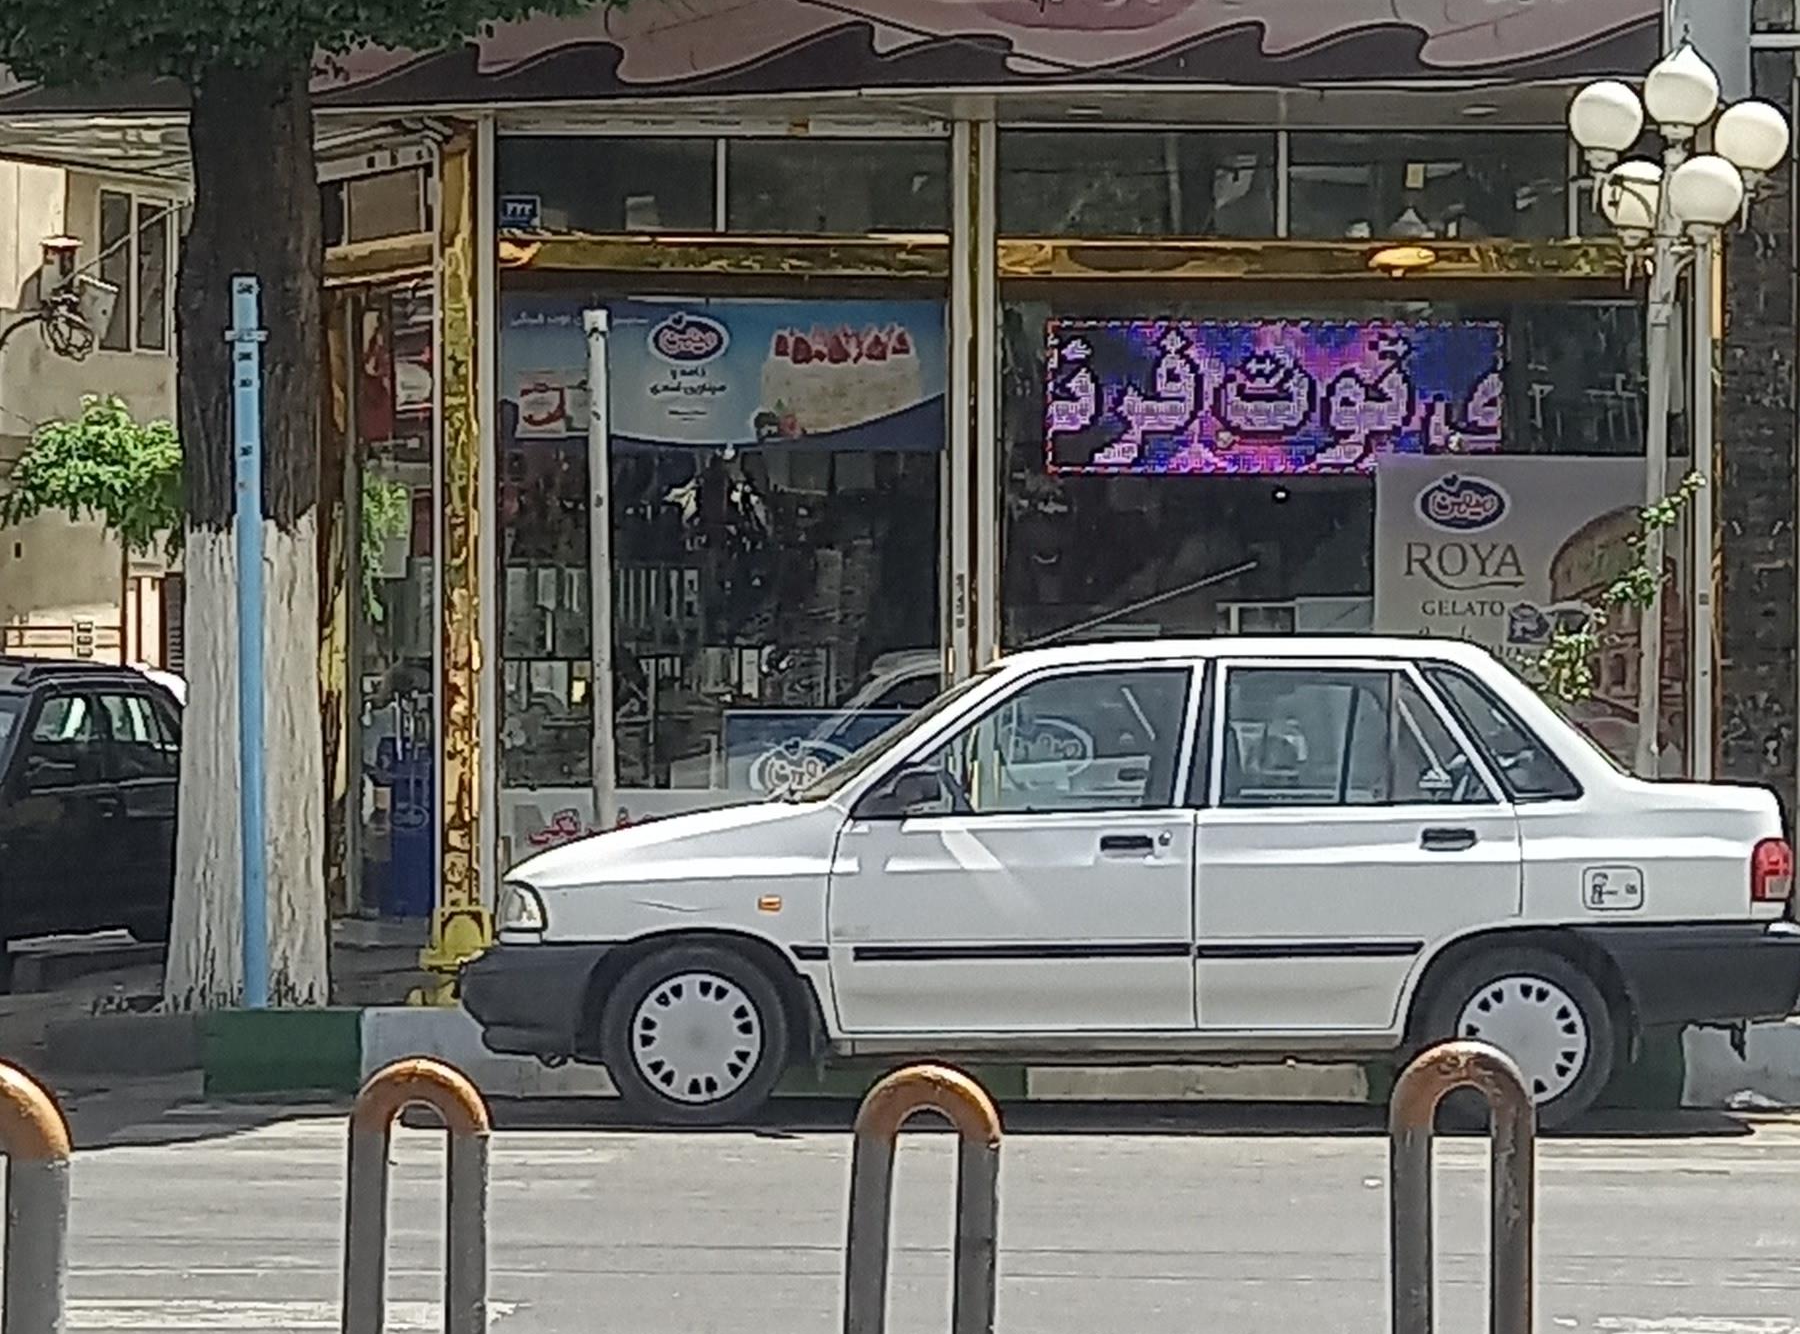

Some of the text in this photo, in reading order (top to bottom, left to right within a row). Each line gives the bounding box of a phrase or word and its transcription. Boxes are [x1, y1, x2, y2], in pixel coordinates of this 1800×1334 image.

[1223, 337, 1410, 465] توت
[1427, 489, 1500, 521] میهن
[1404, 542, 1525, 590] ROYA
[1421, 600, 1505, 617] GELATO
